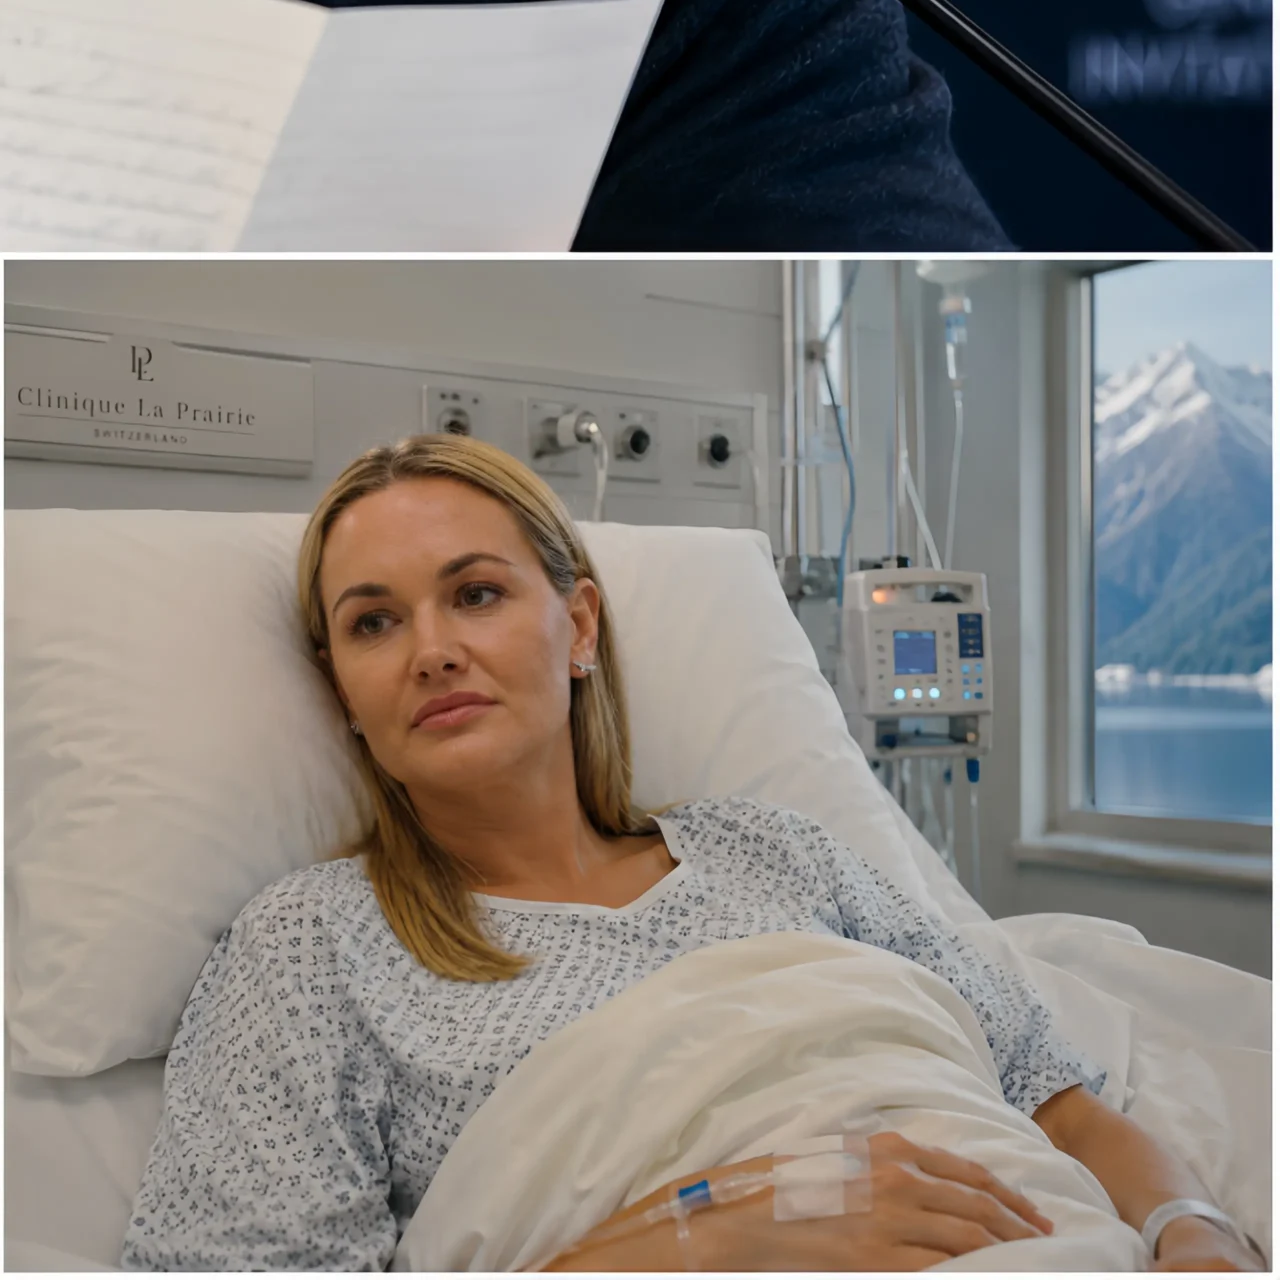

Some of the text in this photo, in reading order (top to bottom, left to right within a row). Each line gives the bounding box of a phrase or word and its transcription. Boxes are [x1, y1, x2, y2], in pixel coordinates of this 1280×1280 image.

[17, 386, 256, 426] Clinique La Prairie
[94, 428, 188, 445] SWITZERLAND
